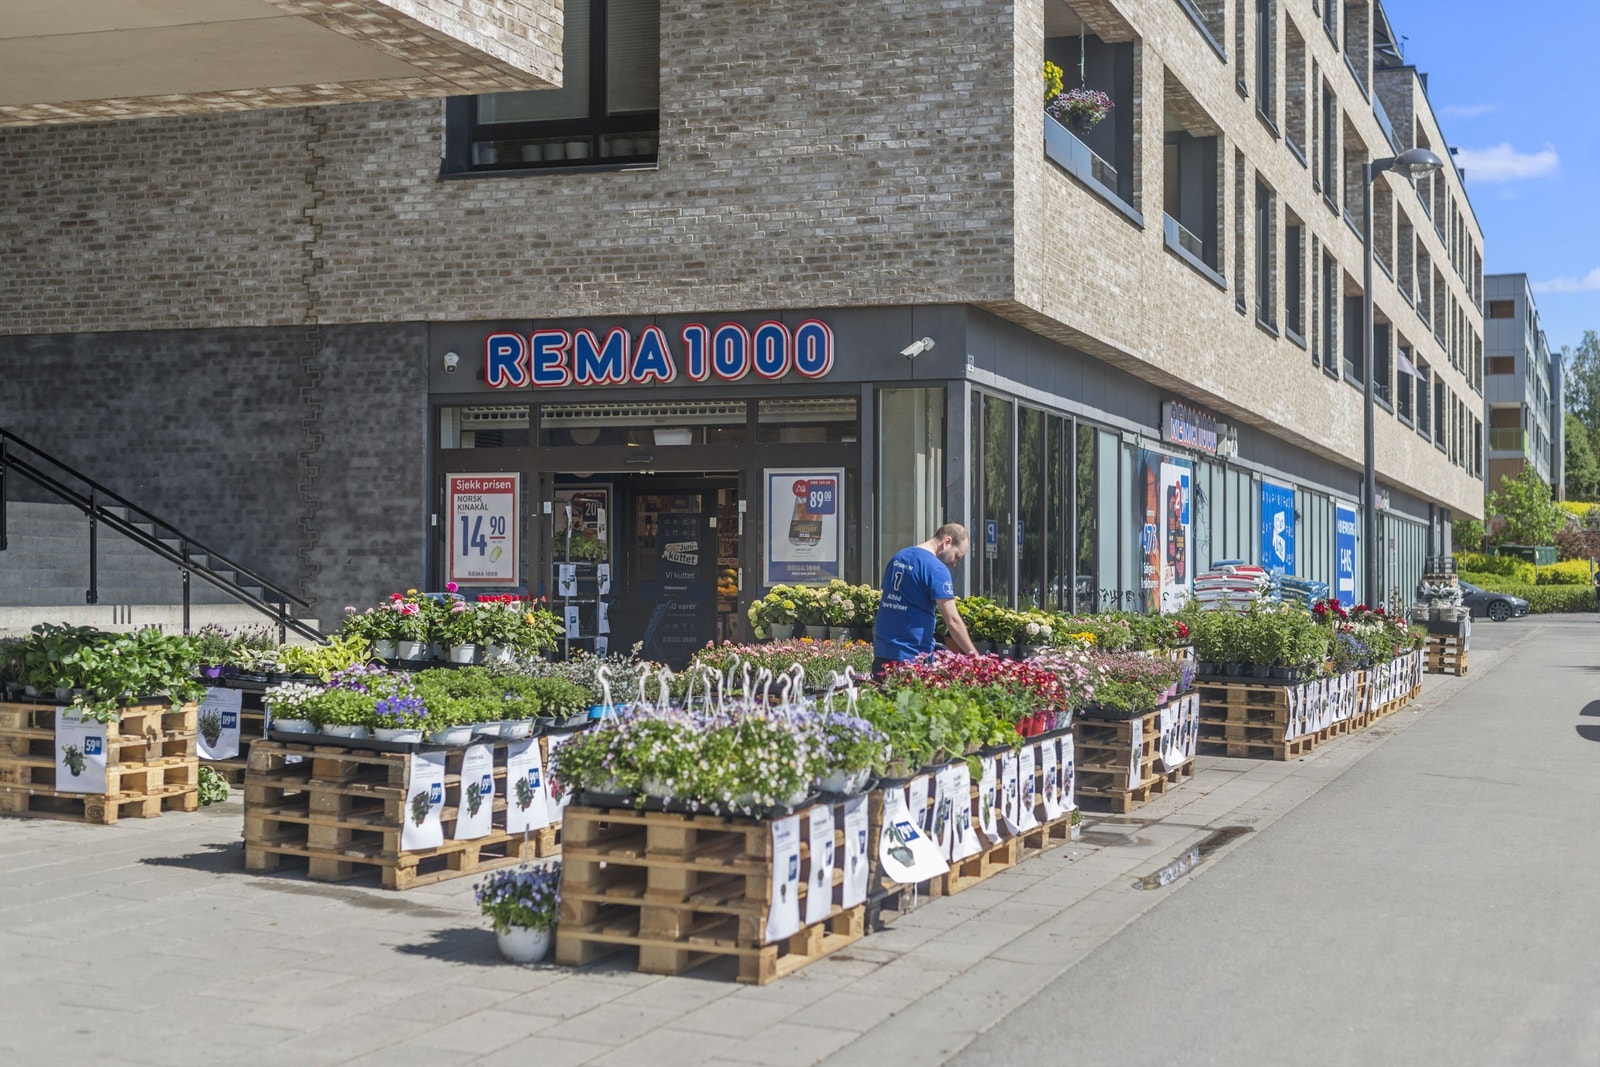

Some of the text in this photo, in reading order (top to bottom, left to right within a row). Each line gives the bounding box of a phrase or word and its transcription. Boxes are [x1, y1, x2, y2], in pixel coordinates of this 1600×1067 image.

[484, 319, 834, 388] REMA 1000
[1170, 400, 1217, 455] REMA 1000
[456, 480, 511, 491] Sjekk prisen
[457, 495, 482, 503] NORSK
[810, 491, 831, 508] 89 00
[457, 502, 488, 511] KINAKÅL
[585, 503, 597, 516] 20
[461, 515, 505, 556] 14 90
[668, 550, 696, 564] kuttet
[674, 571, 695, 579] kutter
[894, 571, 902, 591] 1
[85, 739, 96, 752] 59
